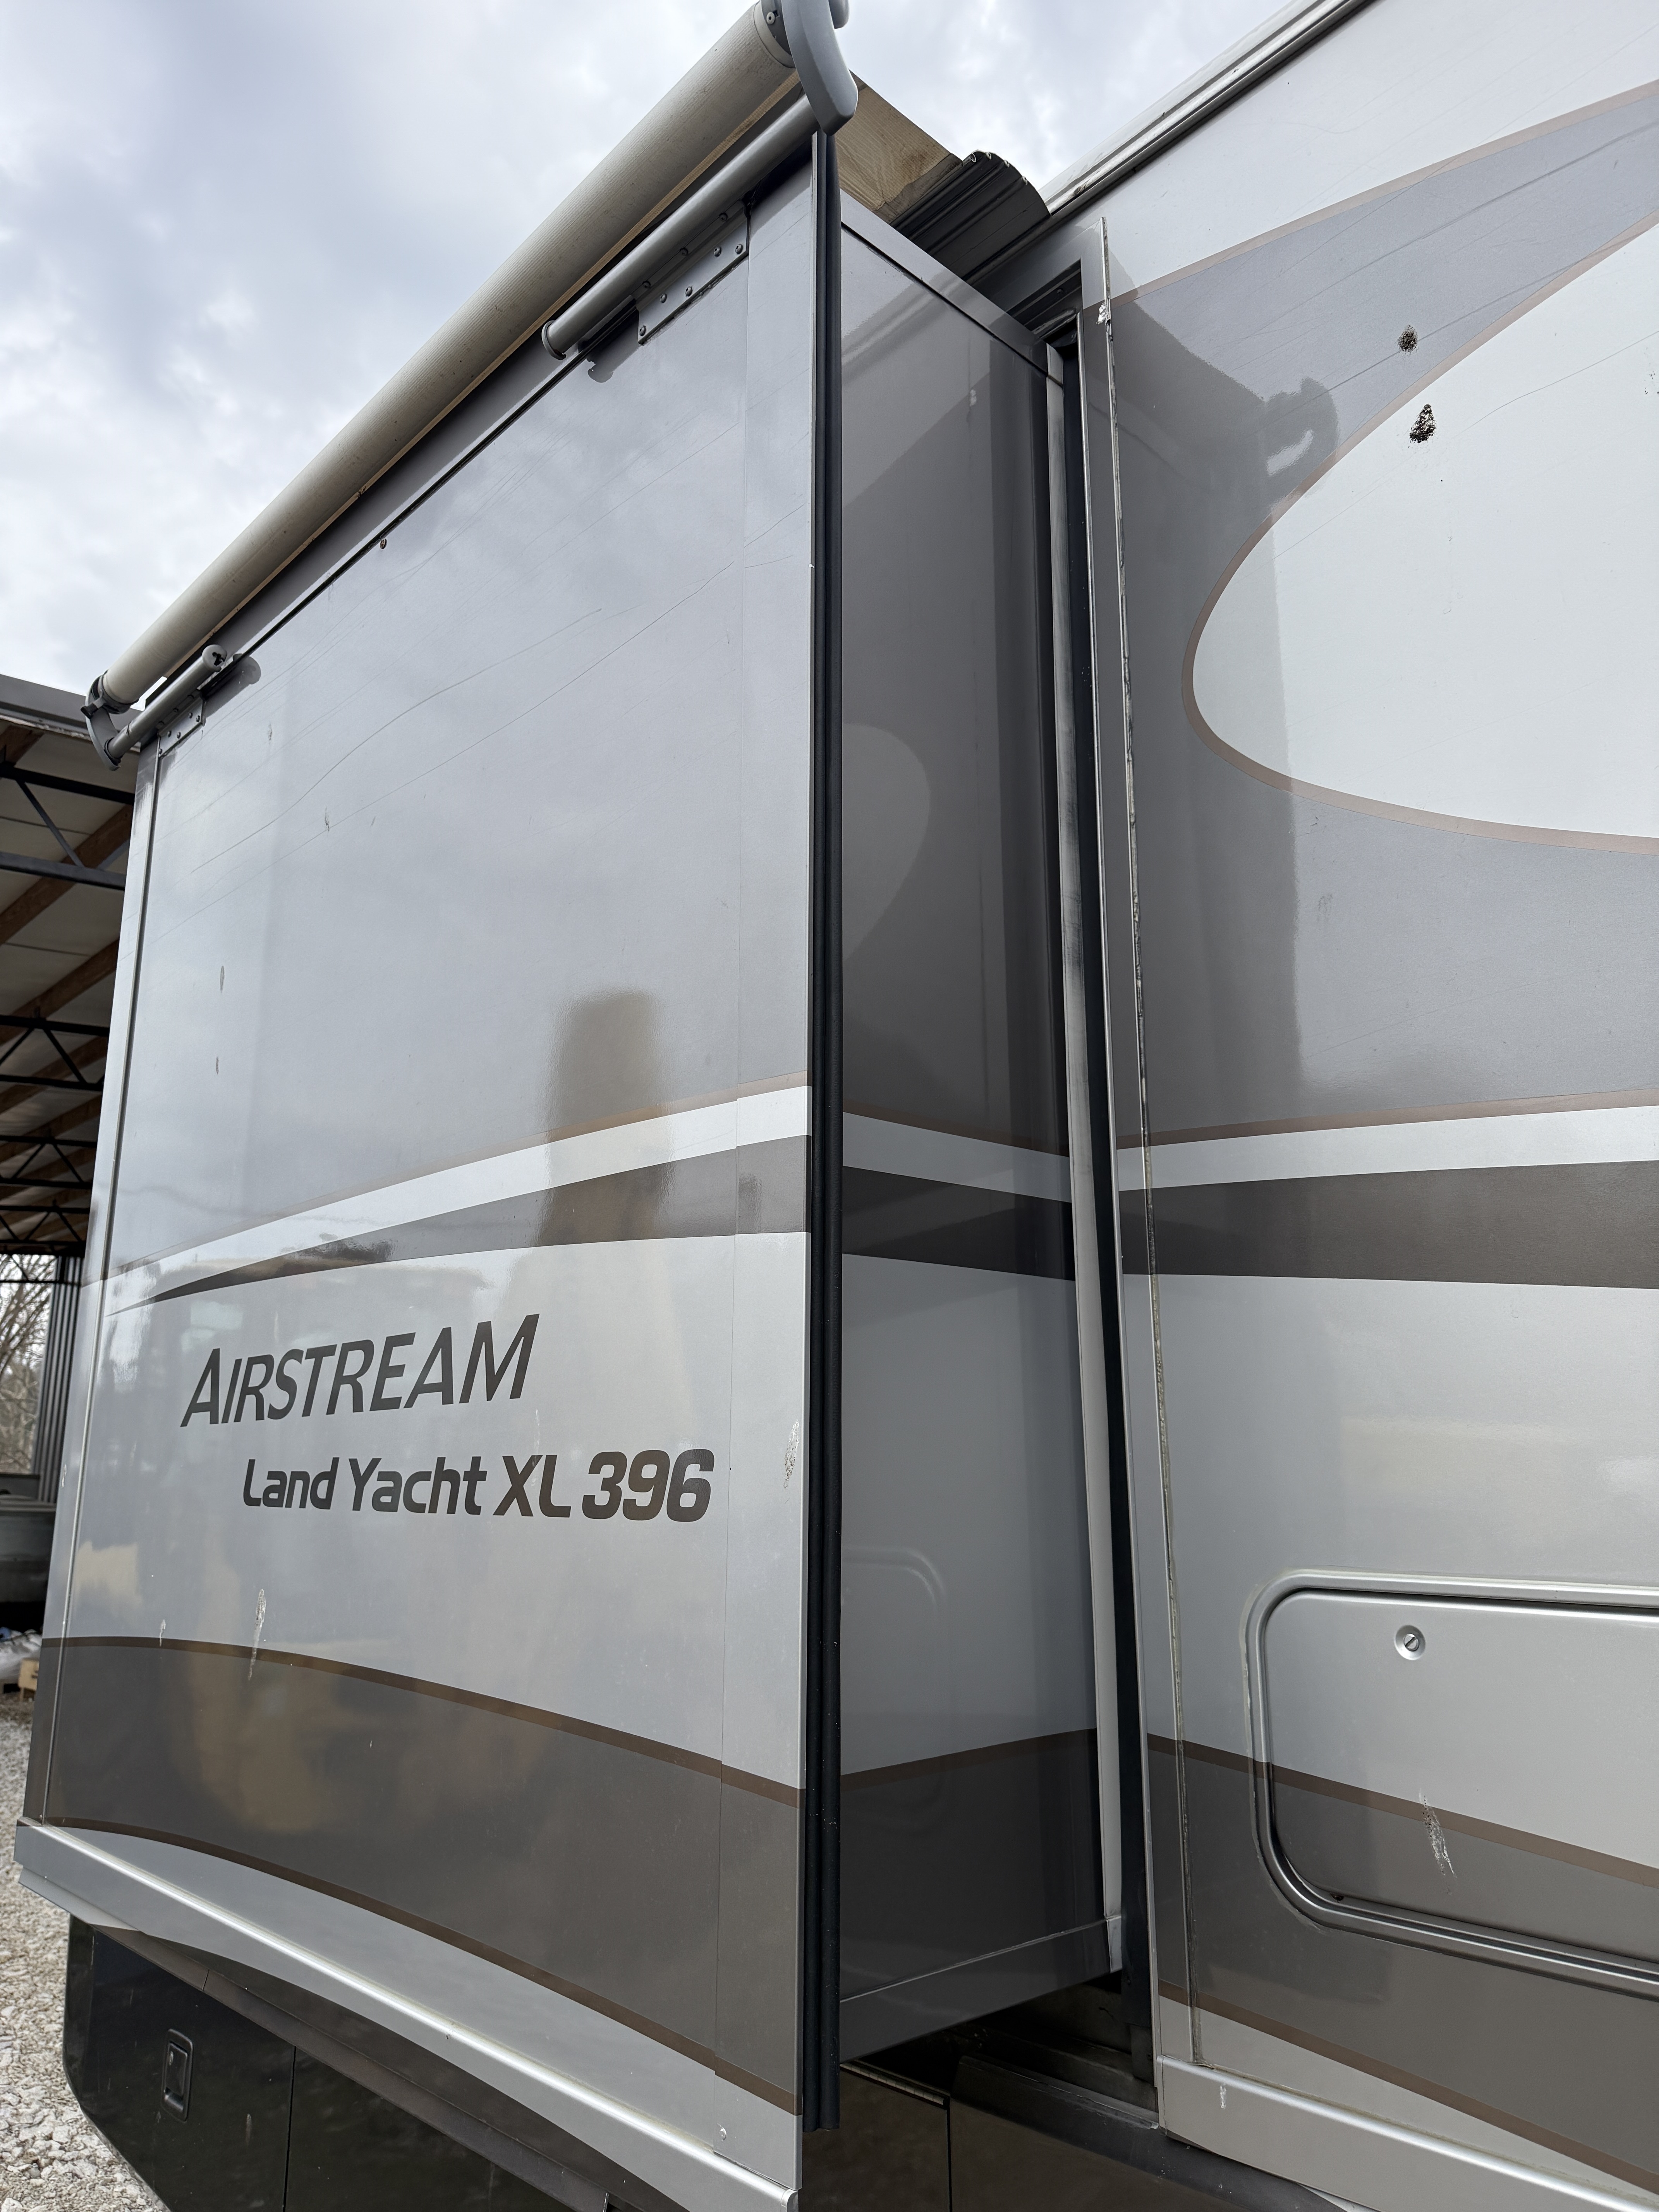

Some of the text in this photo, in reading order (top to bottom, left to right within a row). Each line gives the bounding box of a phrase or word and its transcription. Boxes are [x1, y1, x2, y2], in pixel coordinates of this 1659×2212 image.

[180, 1313, 540, 1427] AIRSTREAM
[243, 1449, 715, 1522] Land Yacht XL 396
